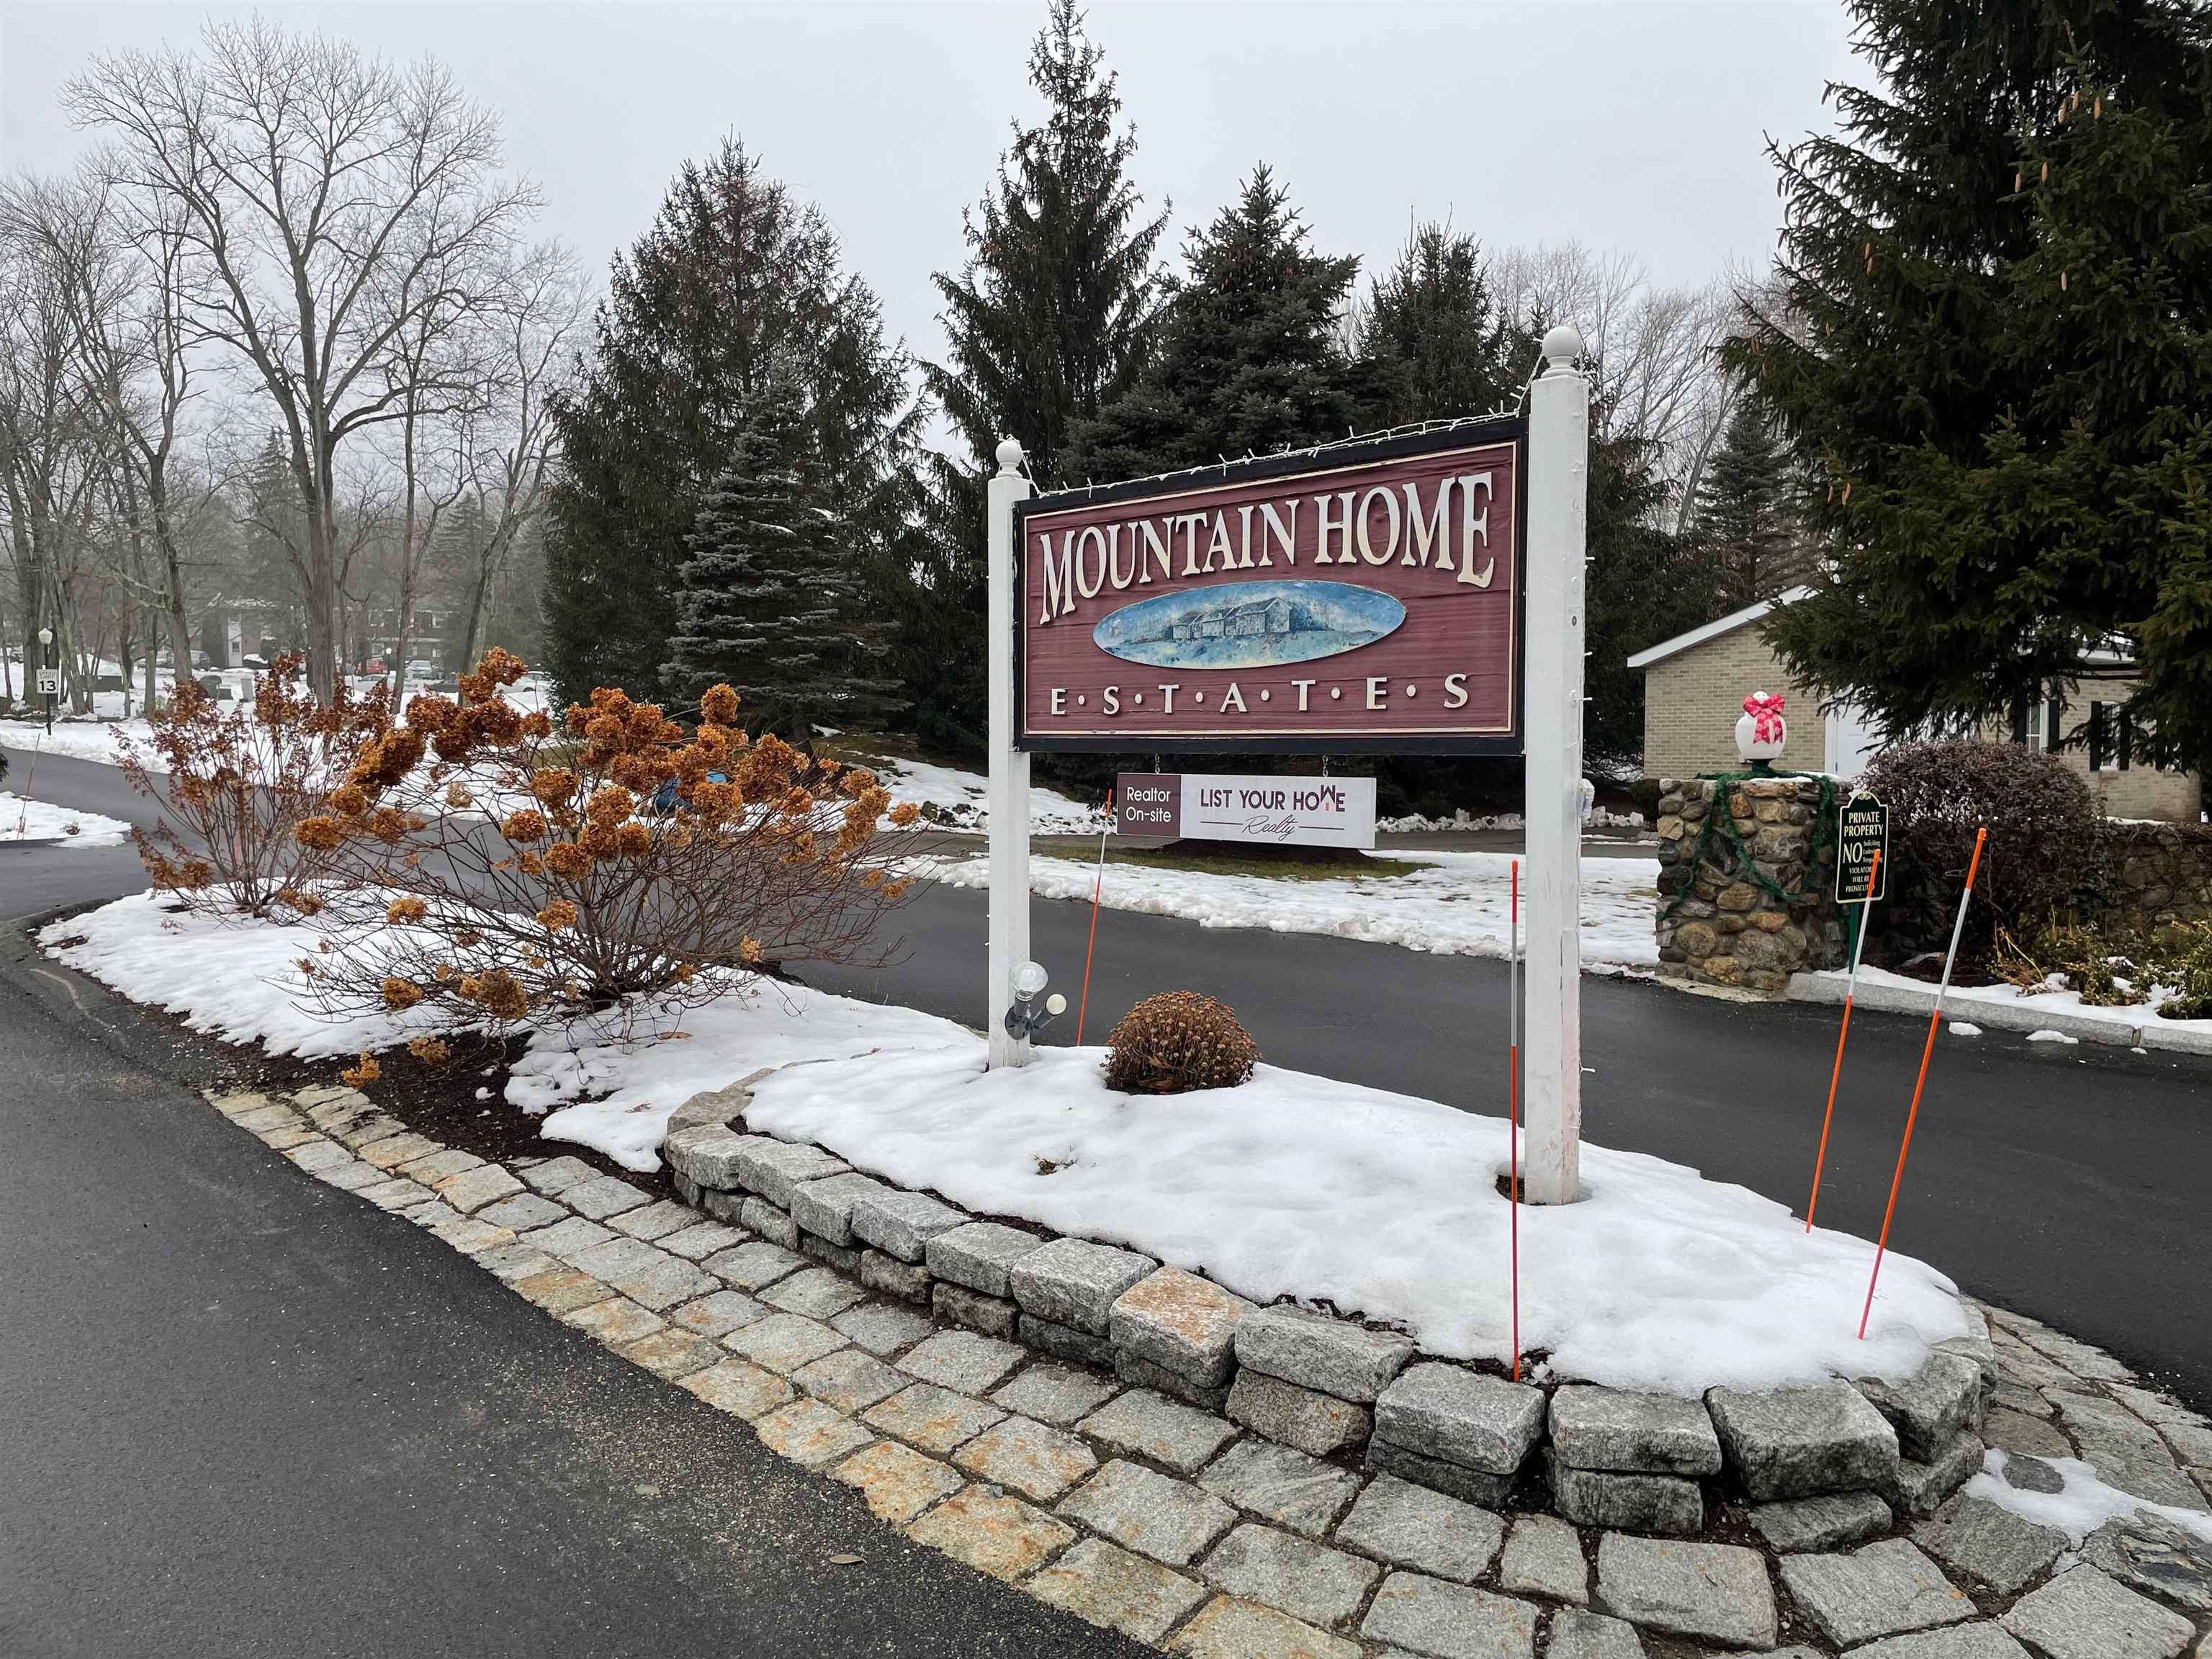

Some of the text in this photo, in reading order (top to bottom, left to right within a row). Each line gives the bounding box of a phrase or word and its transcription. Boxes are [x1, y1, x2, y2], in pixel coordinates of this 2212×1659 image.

[1040, 471, 1495, 625] MOUNTAIN HOME
[39, 680, 56, 691] 13
[1126, 786, 1171, 803] Realtor
[1200, 784, 1345, 812] LIST YOUR HOME
[1125, 806, 1172, 823] On-site
[1848, 811, 1880, 824] PRIVATE
[1241, 814, 1298, 841] Realty
[1843, 824, 1884, 837] PROPERTY
[1843, 842, 1863, 864] NO
[1845, 884, 1875, 893] PROSECUT
